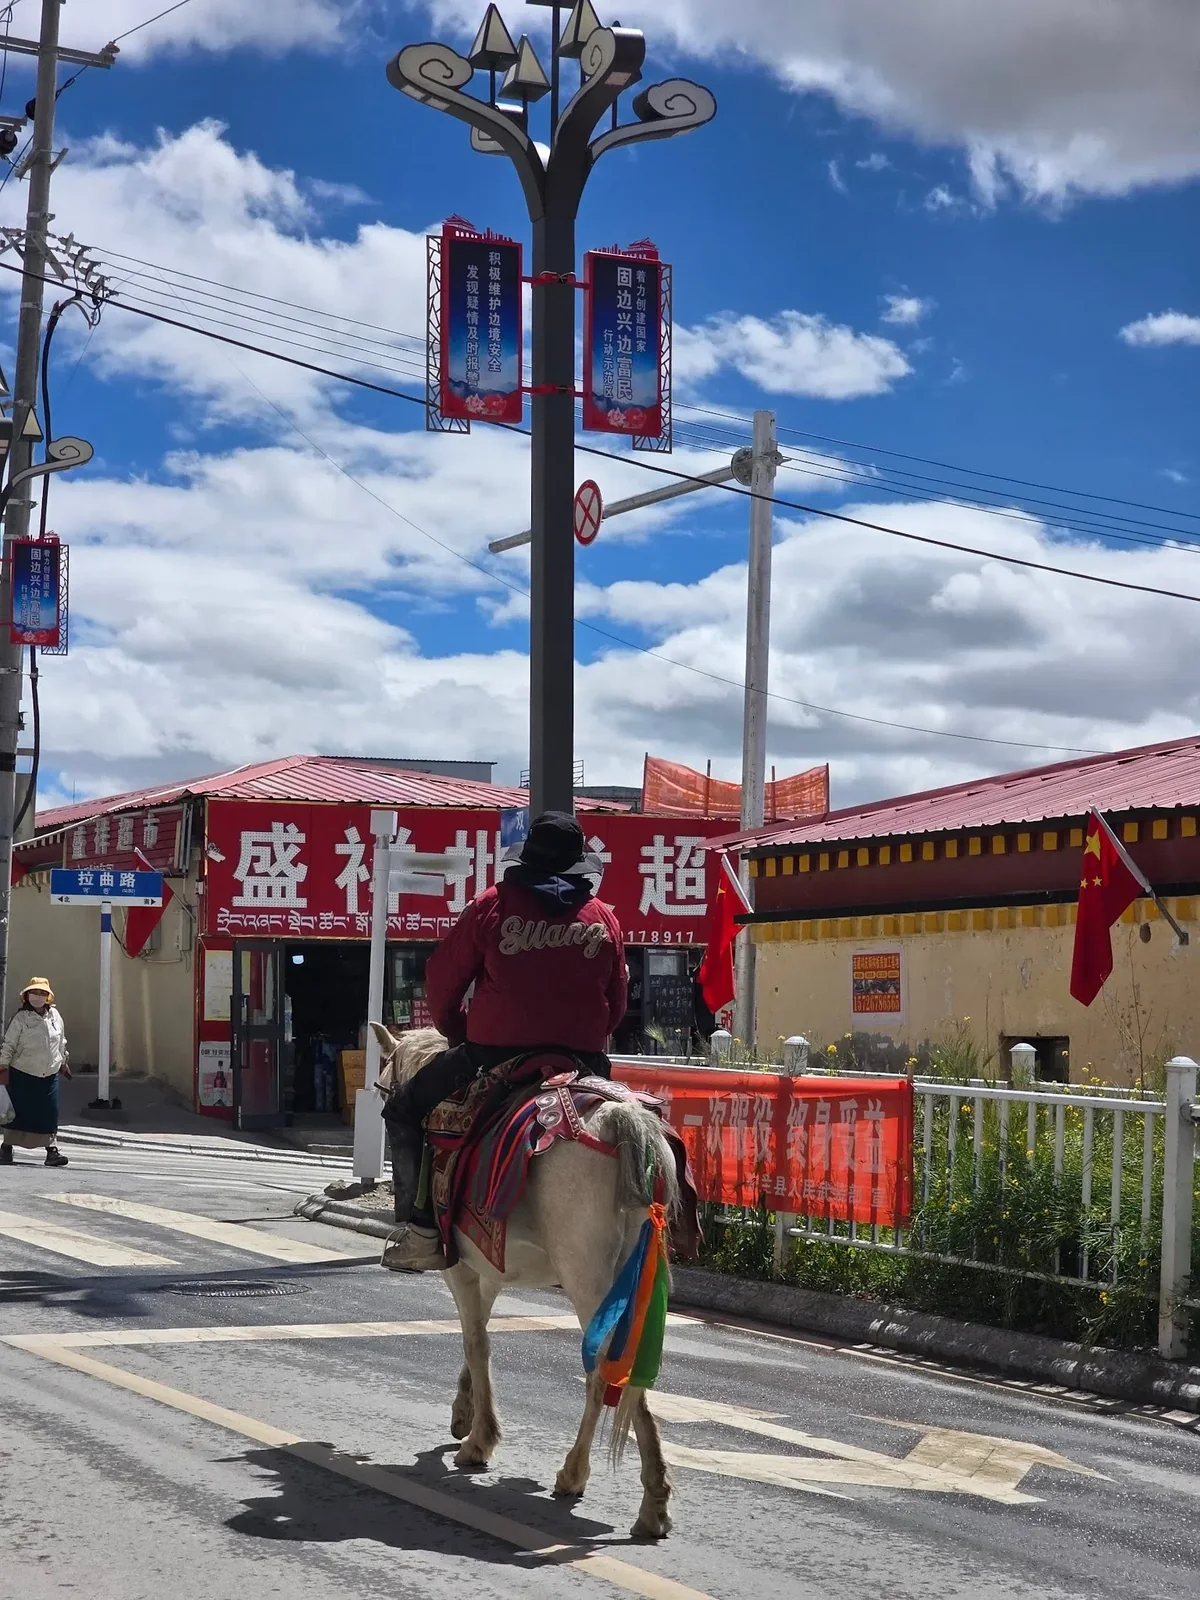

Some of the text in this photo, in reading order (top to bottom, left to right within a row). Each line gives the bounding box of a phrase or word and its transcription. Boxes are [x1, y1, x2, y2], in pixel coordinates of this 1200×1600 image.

[466, 264, 480, 388] 发现疑情及时报警
[488, 251, 502, 372] 积极维护边境安全
[616, 267, 633, 400] 固边兴边富民
[635, 270, 647, 353] 着力创建国家
[603, 329, 614, 399] 行动示范区
[30, 548, 42, 626] 固边兴边富民
[77, 871, 136, 888] 拉曲路
[621, 930, 694, 943] 178917
[786, 1093, 886, 1174] 终身受益
